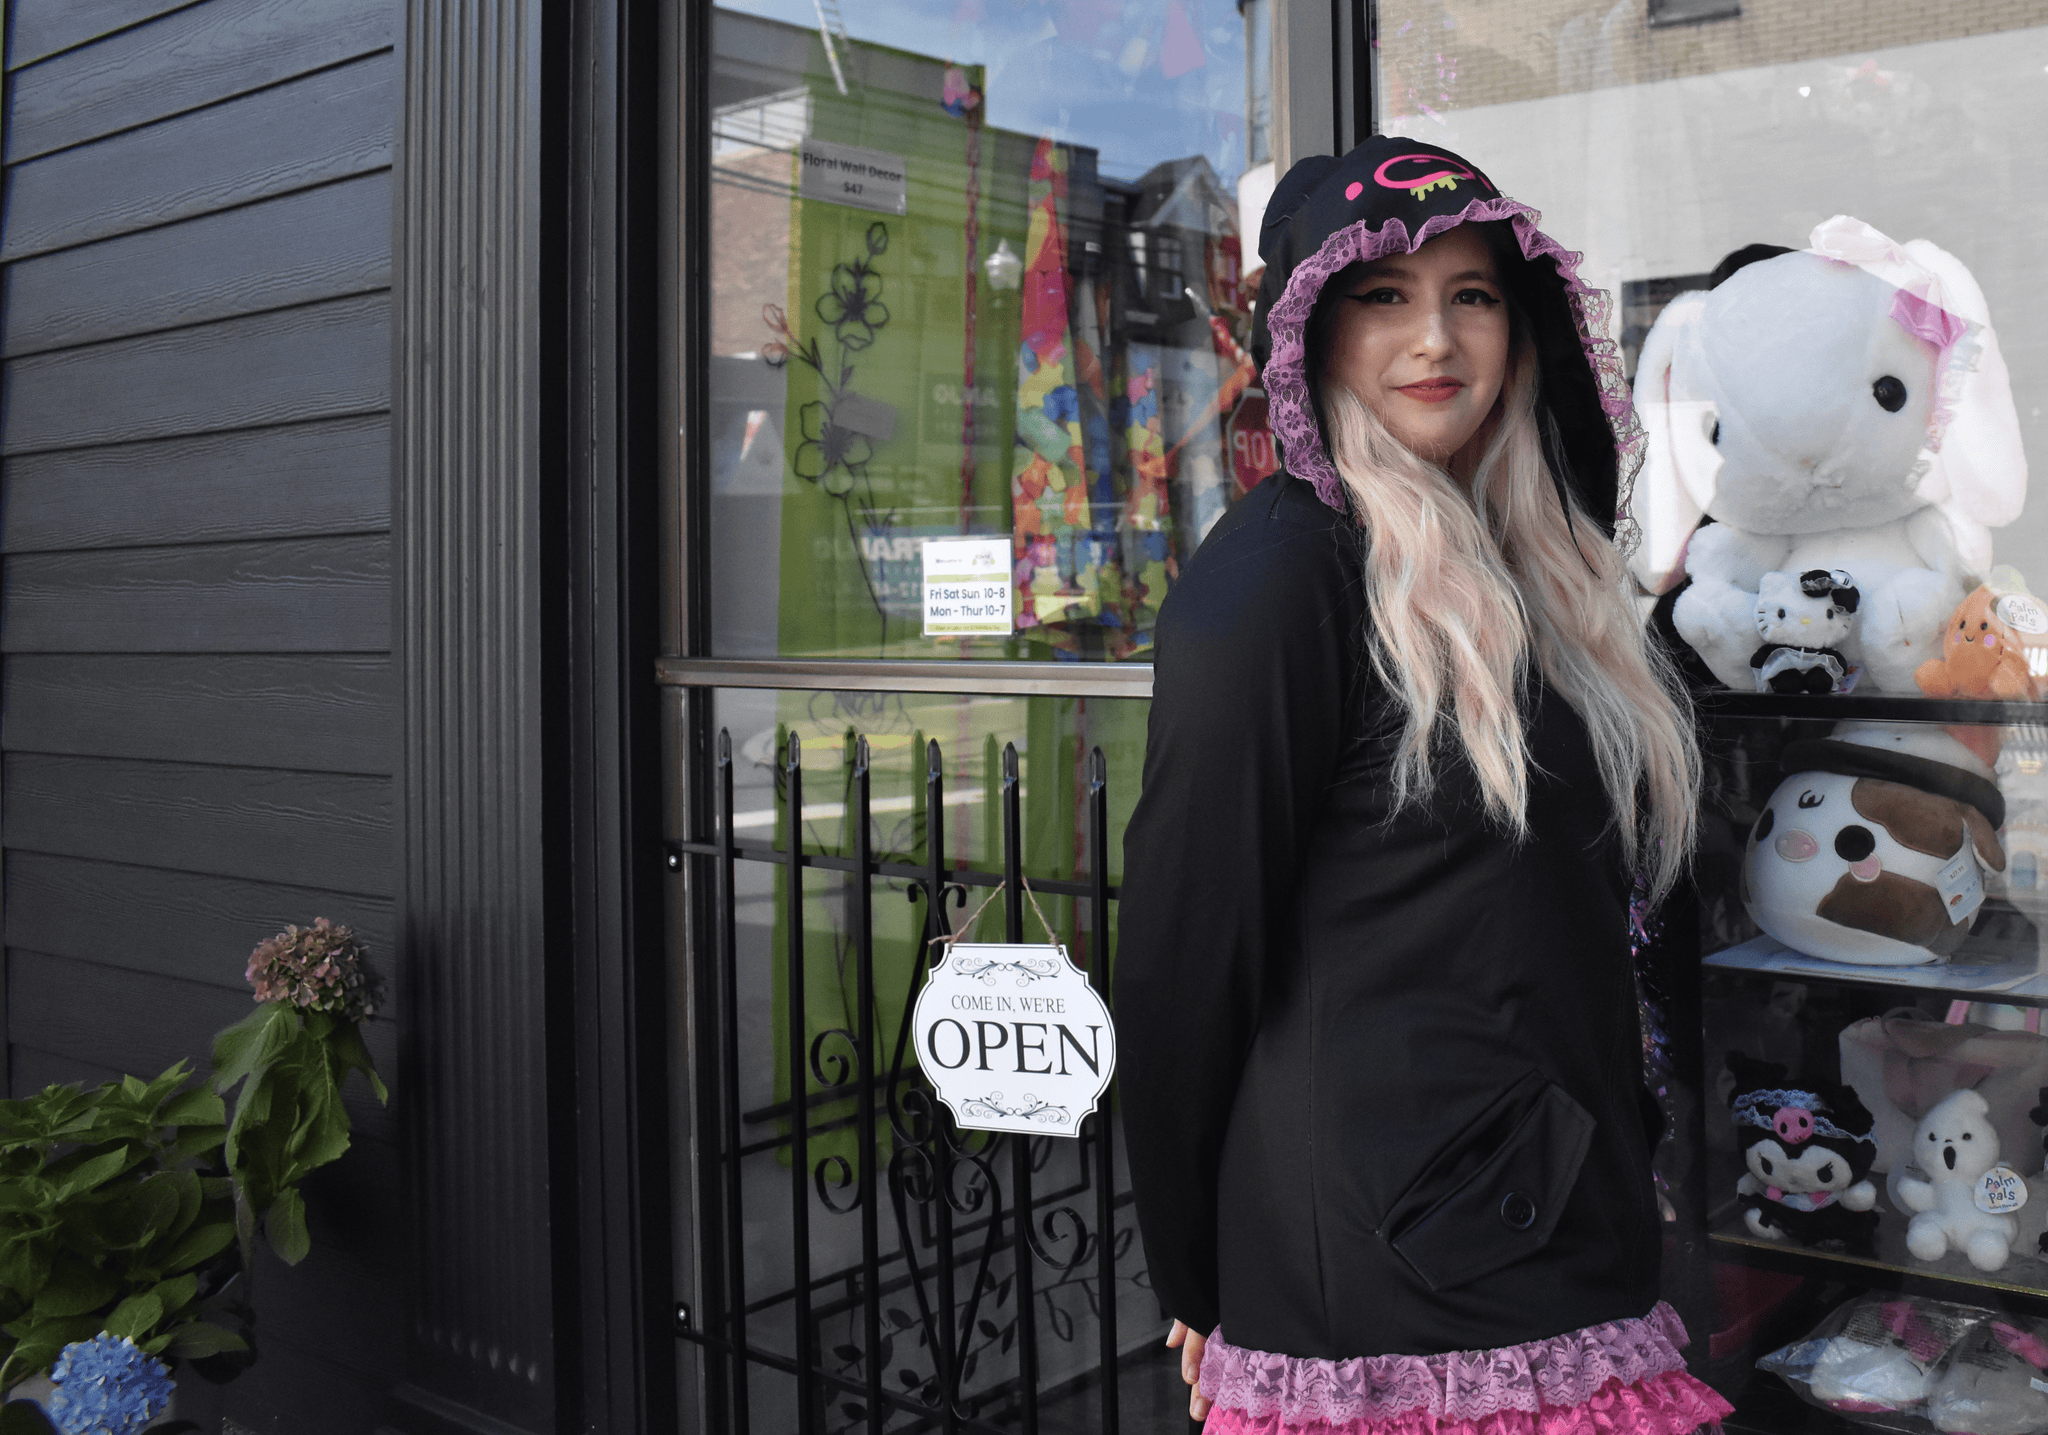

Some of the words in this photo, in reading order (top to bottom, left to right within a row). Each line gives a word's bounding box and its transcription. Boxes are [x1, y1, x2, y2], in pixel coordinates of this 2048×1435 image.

[803, 152, 837, 169] Floral
[840, 160, 866, 175] Wall
[868, 166, 901, 181] Decor
[844, 181, 863, 194] $47
[930, 588, 942, 599] Fri
[944, 588, 960, 599] Sat
[961, 588, 980, 599] Sun
[984, 587, 1005, 599] 10-8
[930, 606, 952, 616] Mon
[961, 605, 983, 616] Thur
[985, 604, 1006, 616] 10-7
[2009, 600, 2038, 615] Palm
[951, 995, 993, 1011] COME
[997, 996, 1016, 1014] IN,
[1019, 997, 1066, 1013] WE'RE
[927, 1018, 1103, 1078] OPEN
[1985, 1175, 2015, 1189] Palm
